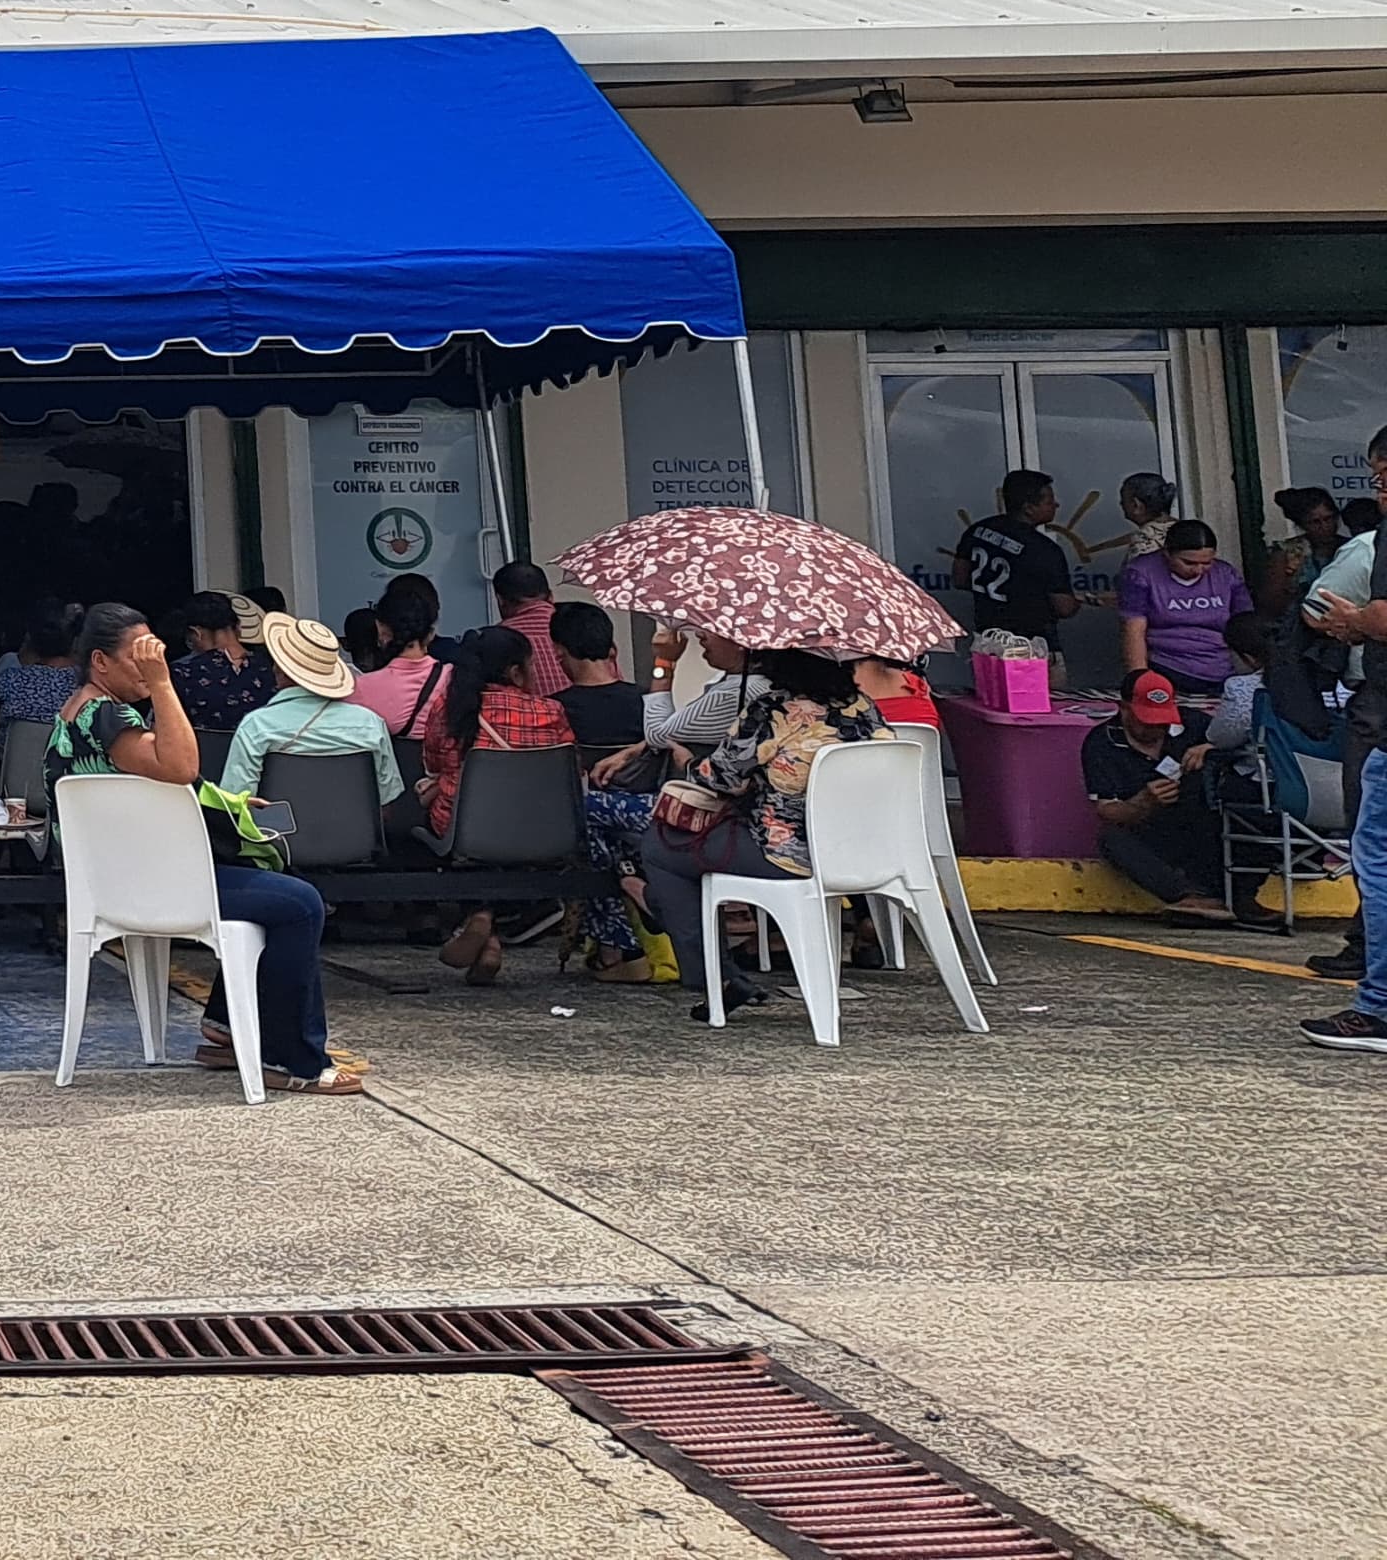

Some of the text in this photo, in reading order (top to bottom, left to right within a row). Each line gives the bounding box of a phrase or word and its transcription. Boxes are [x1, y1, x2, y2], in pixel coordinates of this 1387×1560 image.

[368, 441, 419, 454] CENTRO
[353, 461, 436, 474] PREVENTIVO
[652, 457, 722, 473] CLÍNICA
[333, 480, 386, 493] CONTRA
[390, 481, 406, 493] EL
[971, 547, 1010, 602] 22
[1168, 596, 1224, 610] AVON
